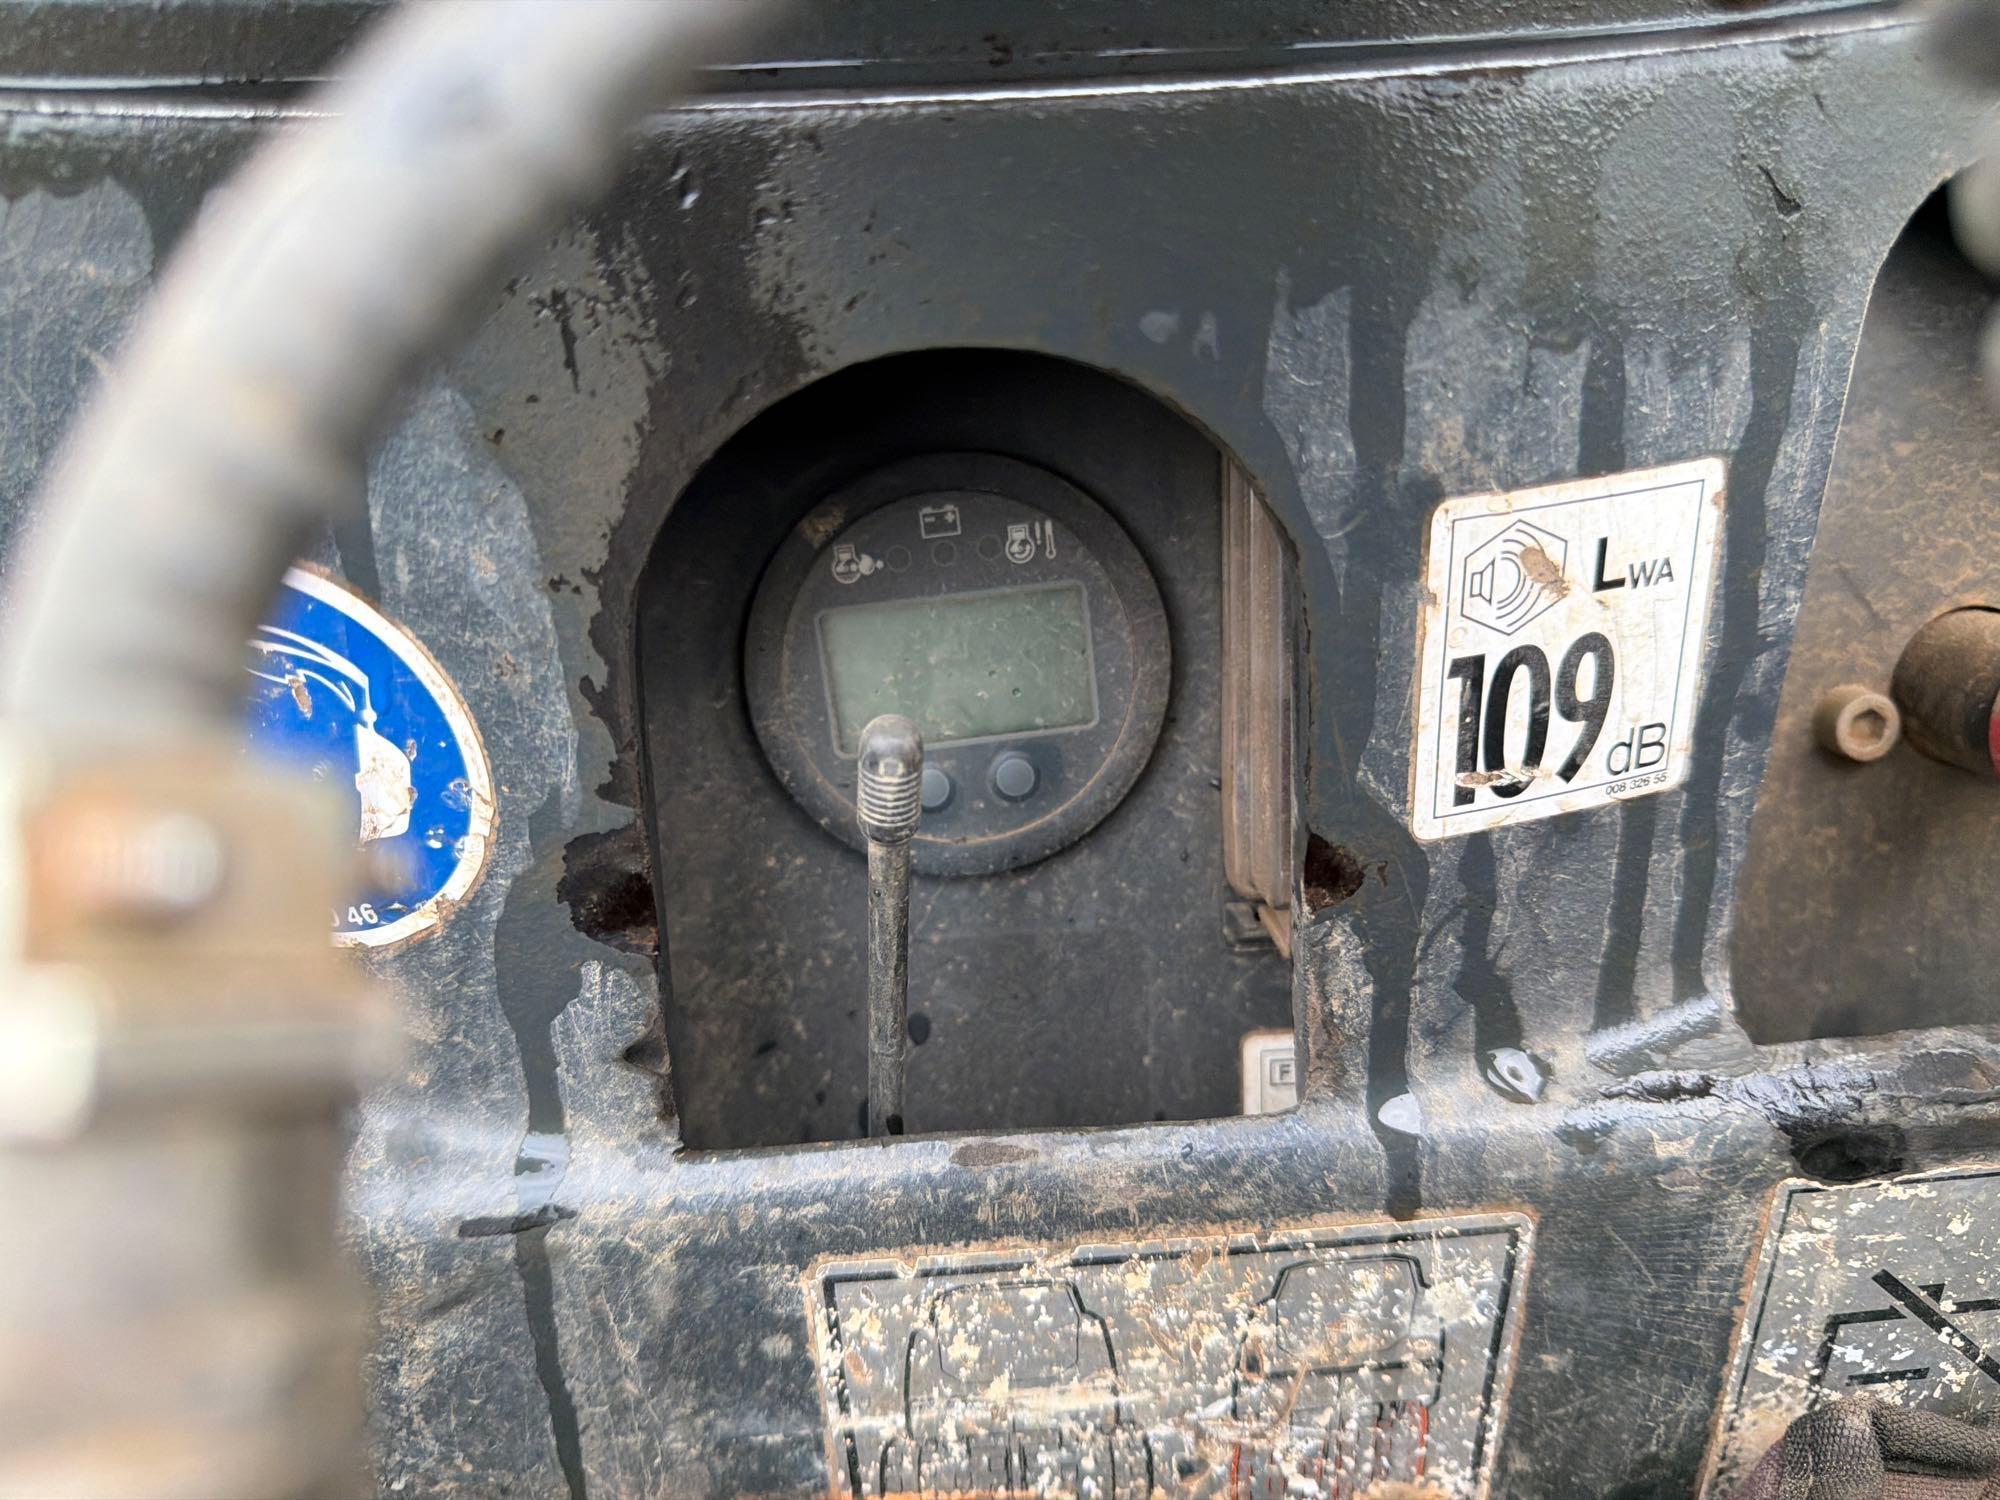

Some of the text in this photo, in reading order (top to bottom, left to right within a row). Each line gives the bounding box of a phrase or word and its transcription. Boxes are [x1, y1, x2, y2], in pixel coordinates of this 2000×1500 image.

[1447, 631, 1615, 807] 109
[1605, 722, 1667, 775] dB
[348, 903, 378, 926] 46
